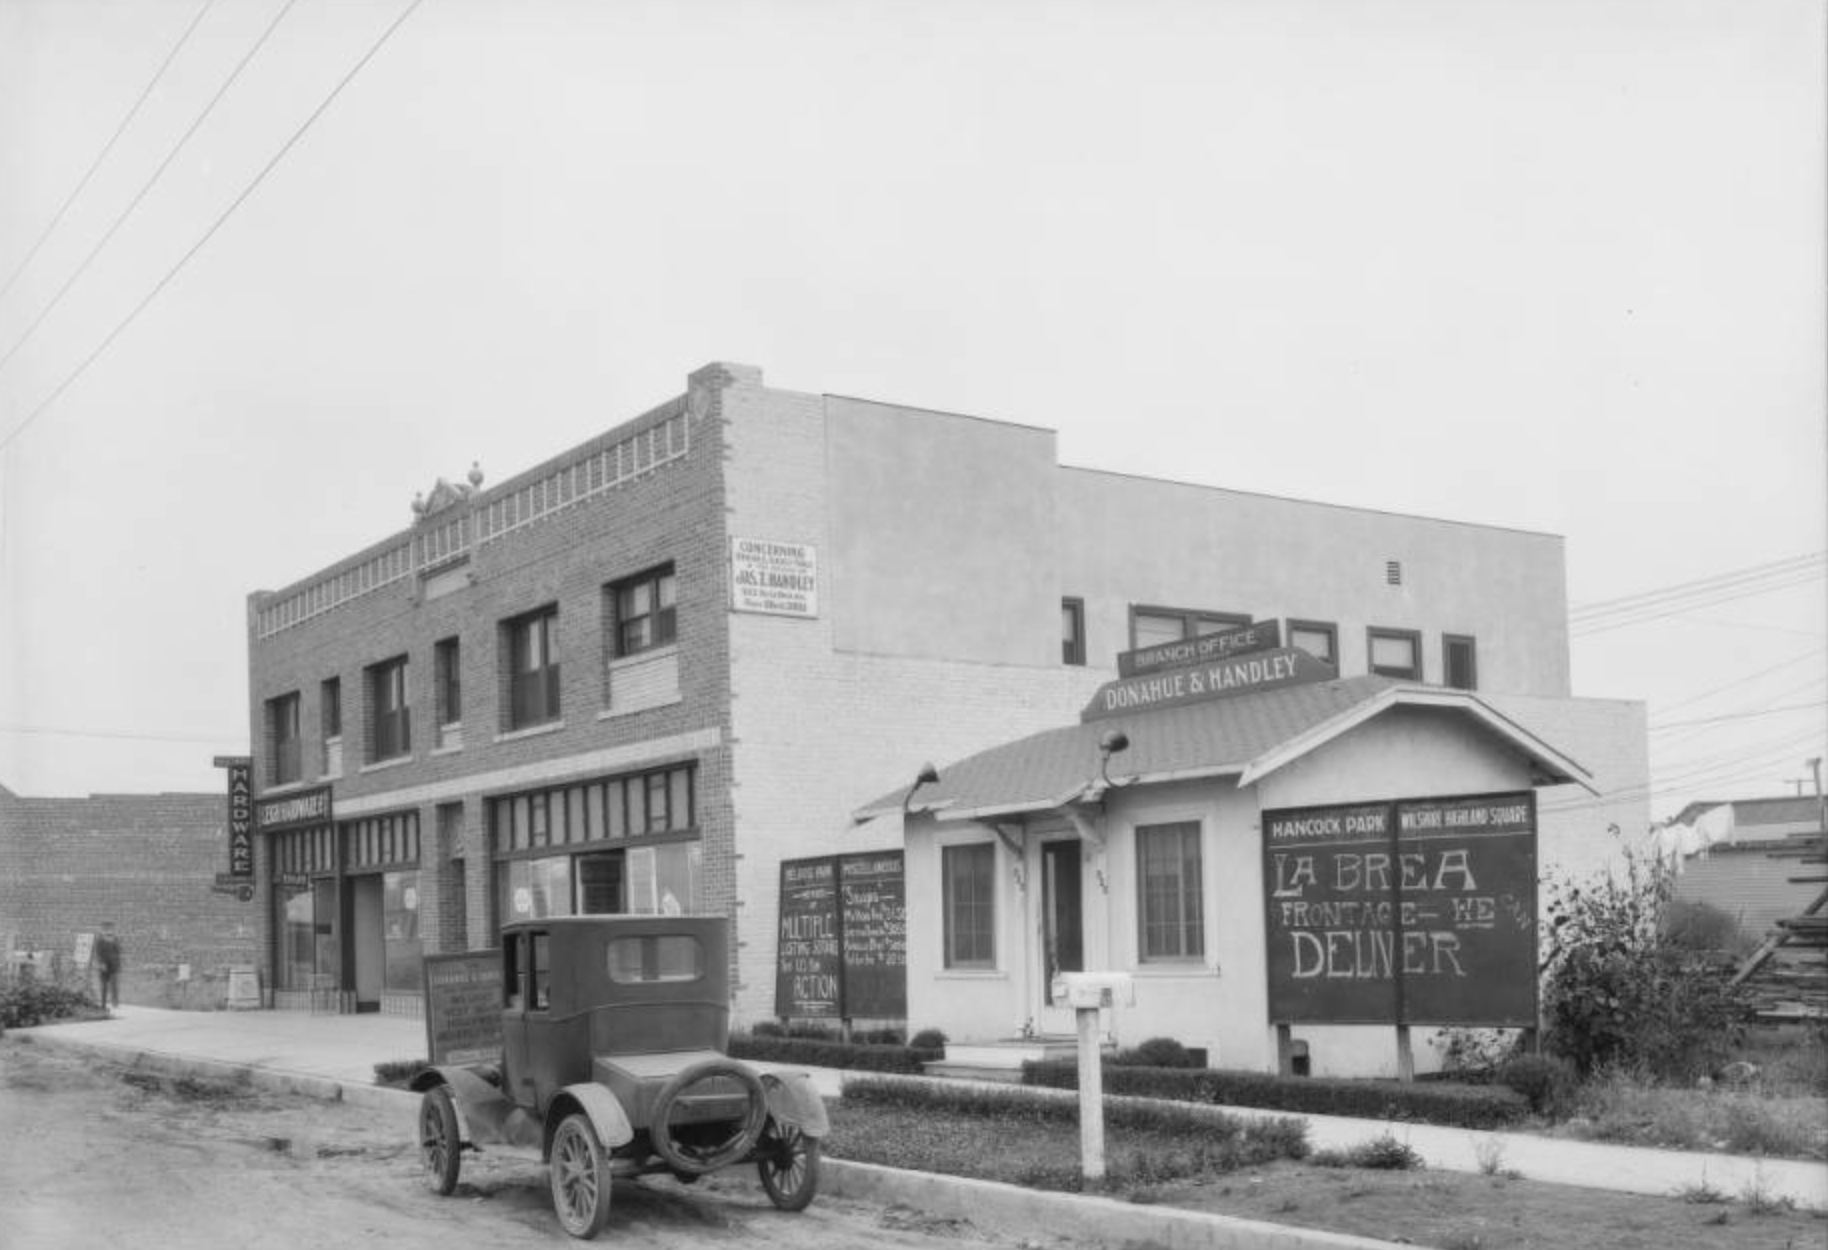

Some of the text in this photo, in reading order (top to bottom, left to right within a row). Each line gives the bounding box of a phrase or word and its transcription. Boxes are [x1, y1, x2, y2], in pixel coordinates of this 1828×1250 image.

[769, 572, 815, 592] HANDLEY
[1137, 630, 1259, 666] BRANCH OFFICE
[1105, 653, 1298, 711] DONAHUE & HANDLEY
[232, 769, 250, 872] HARDWARE
[1272, 814, 1385, 838] HANCOCK PARK
[1444, 808, 1488, 827] HIGHLAND
[1490, 805, 1528, 828] SQUARE
[1272, 849, 1478, 898] LA BREA
[1452, 897, 1495, 922] WE
[1289, 930, 1467, 979] DELIVER
[793, 974, 838, 999] ACTION
